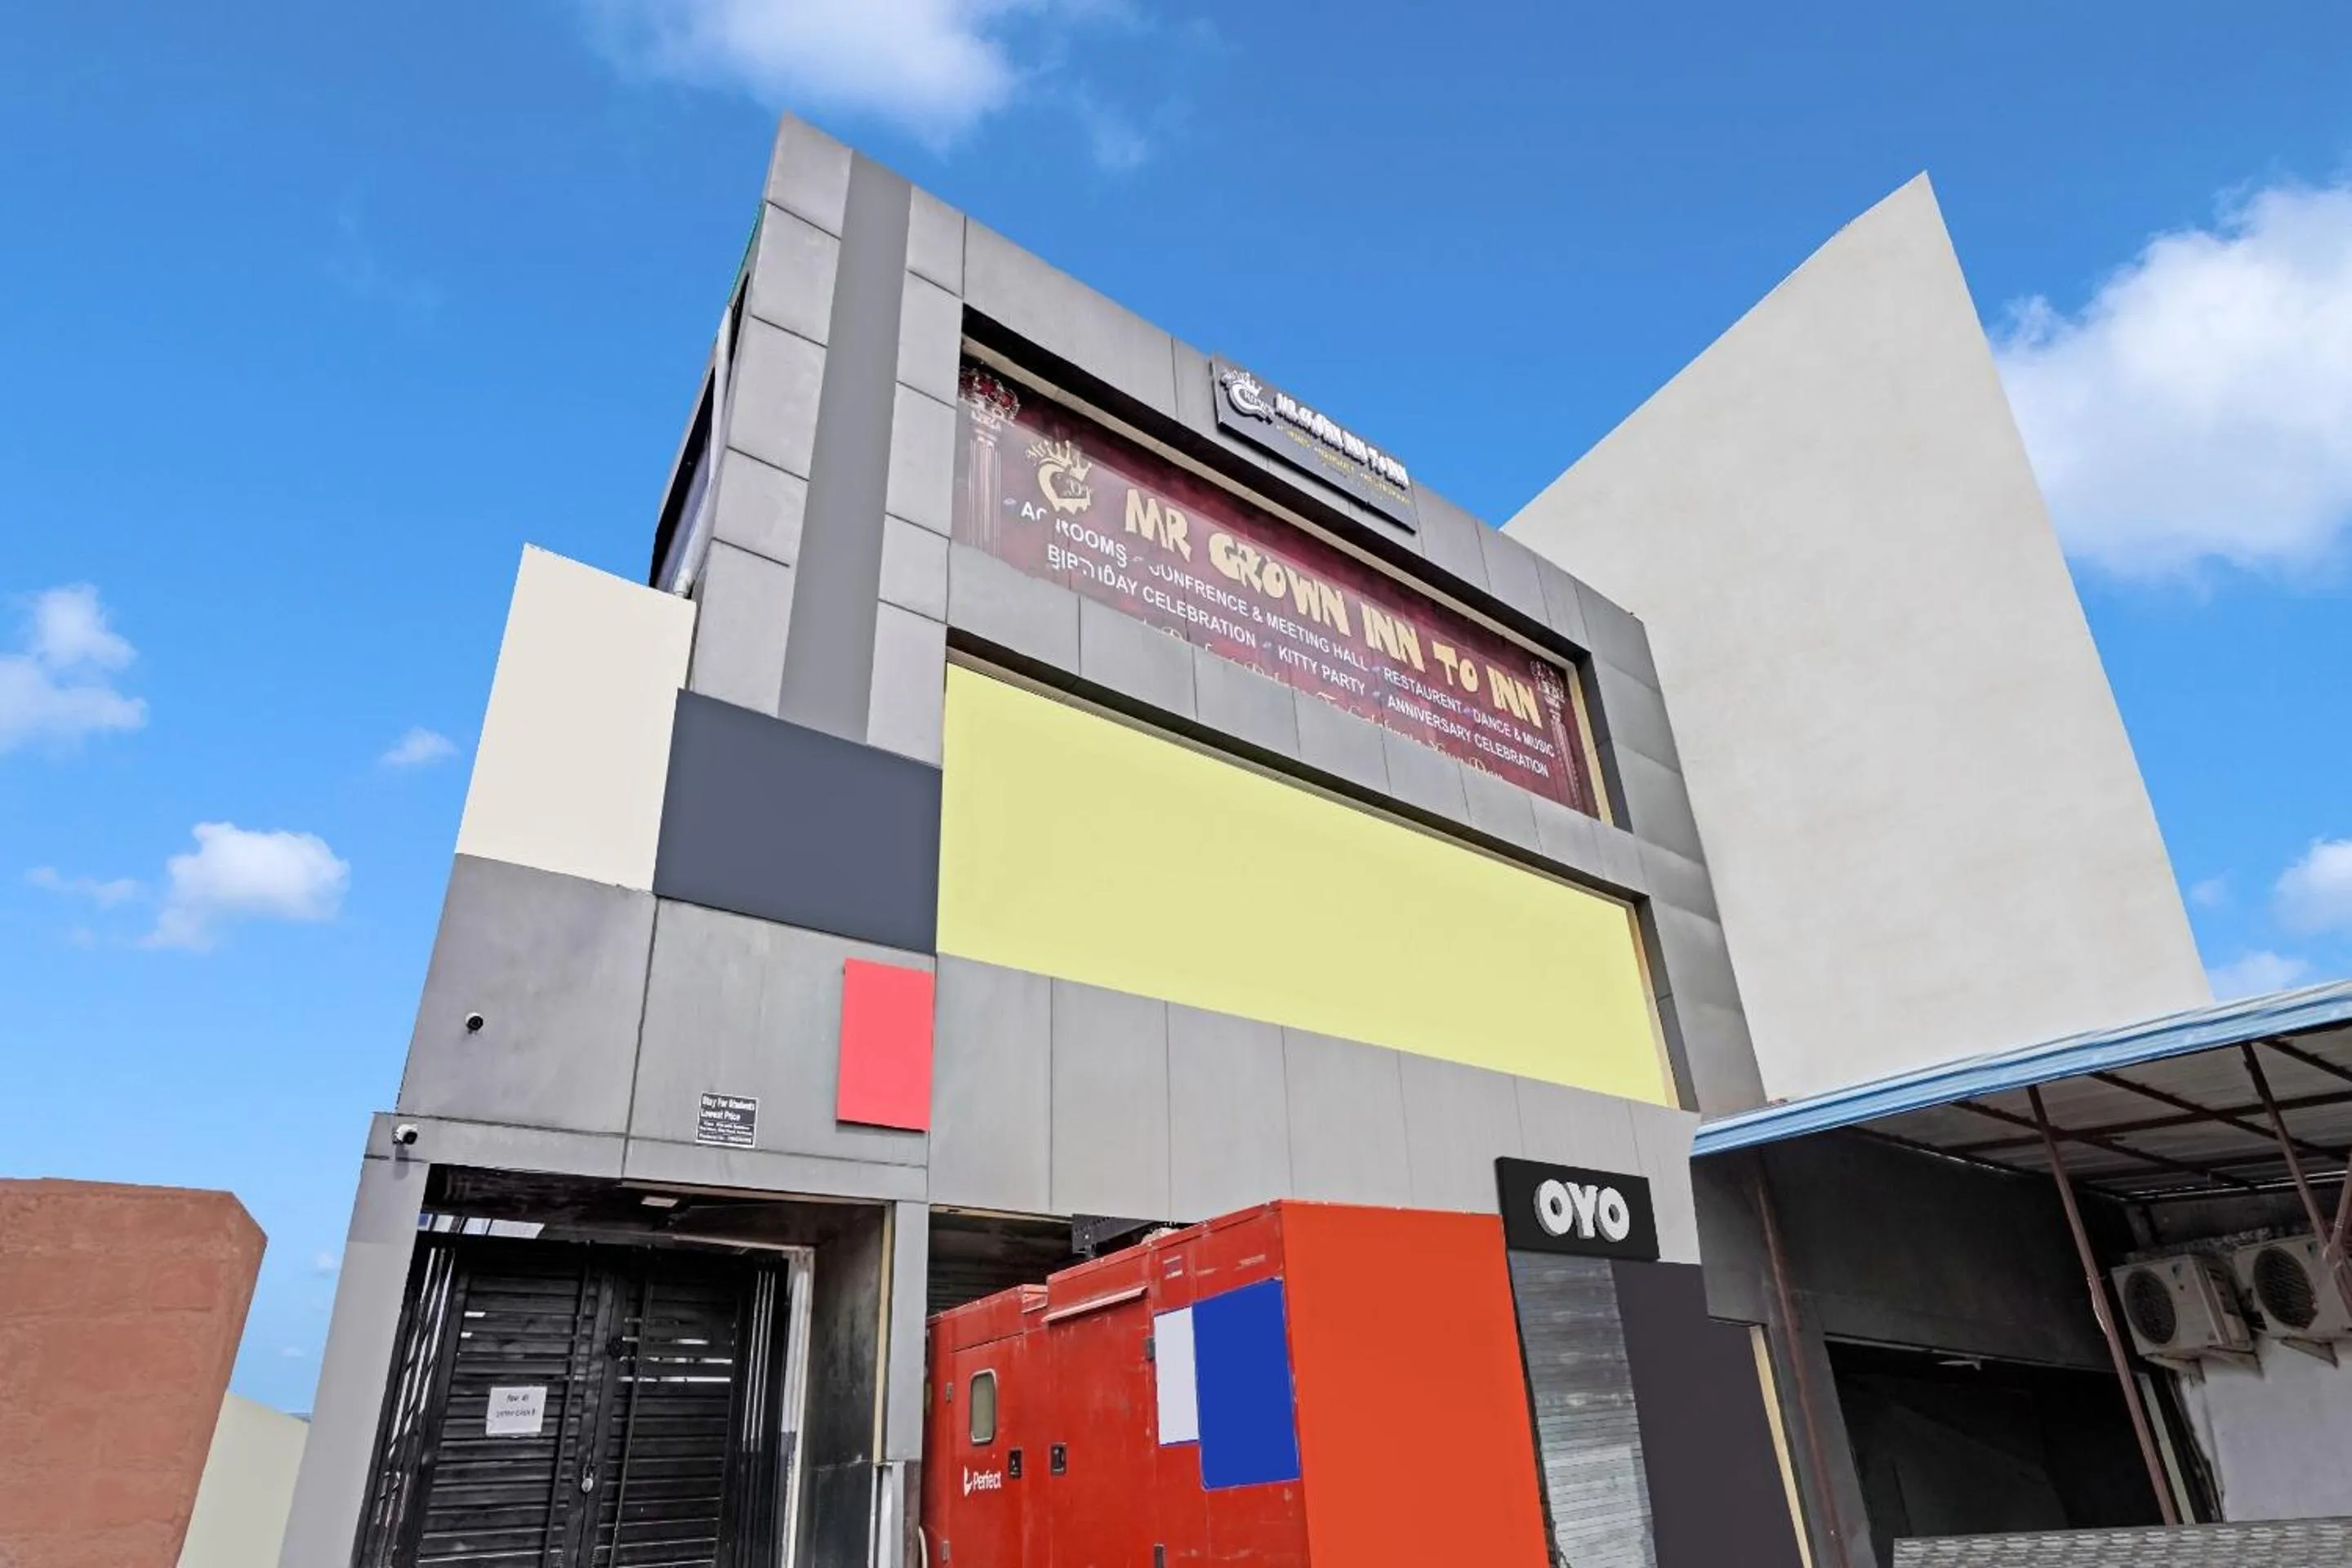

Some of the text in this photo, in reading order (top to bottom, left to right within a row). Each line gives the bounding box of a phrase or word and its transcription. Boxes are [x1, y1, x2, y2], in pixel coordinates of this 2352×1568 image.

[1125, 489, 1192, 563] MR
[1360, 602, 1426, 674] INN
[1432, 640, 1480, 693] TO
[1486, 665, 1544, 730] INN
[1143, 586, 1256, 648] CELEBRATION
[1278, 645, 1318, 675] KITTY
[1321, 665, 1365, 697] PARTY
[1388, 694, 1472, 742] ANNIVERSARY
[1474, 733, 1549, 778] CELEBRATION
[1266, 612, 1330, 653] MEETING
[1333, 643, 1369, 672] HALL
[1383, 667, 1462, 713] RESTAURENT
[1472, 708, 1512, 737] DANCE
[1522, 732, 1555, 758] MUSIC
[1533, 1178, 1630, 1242] OYO
[973, 1469, 1002, 1490] Perfect
